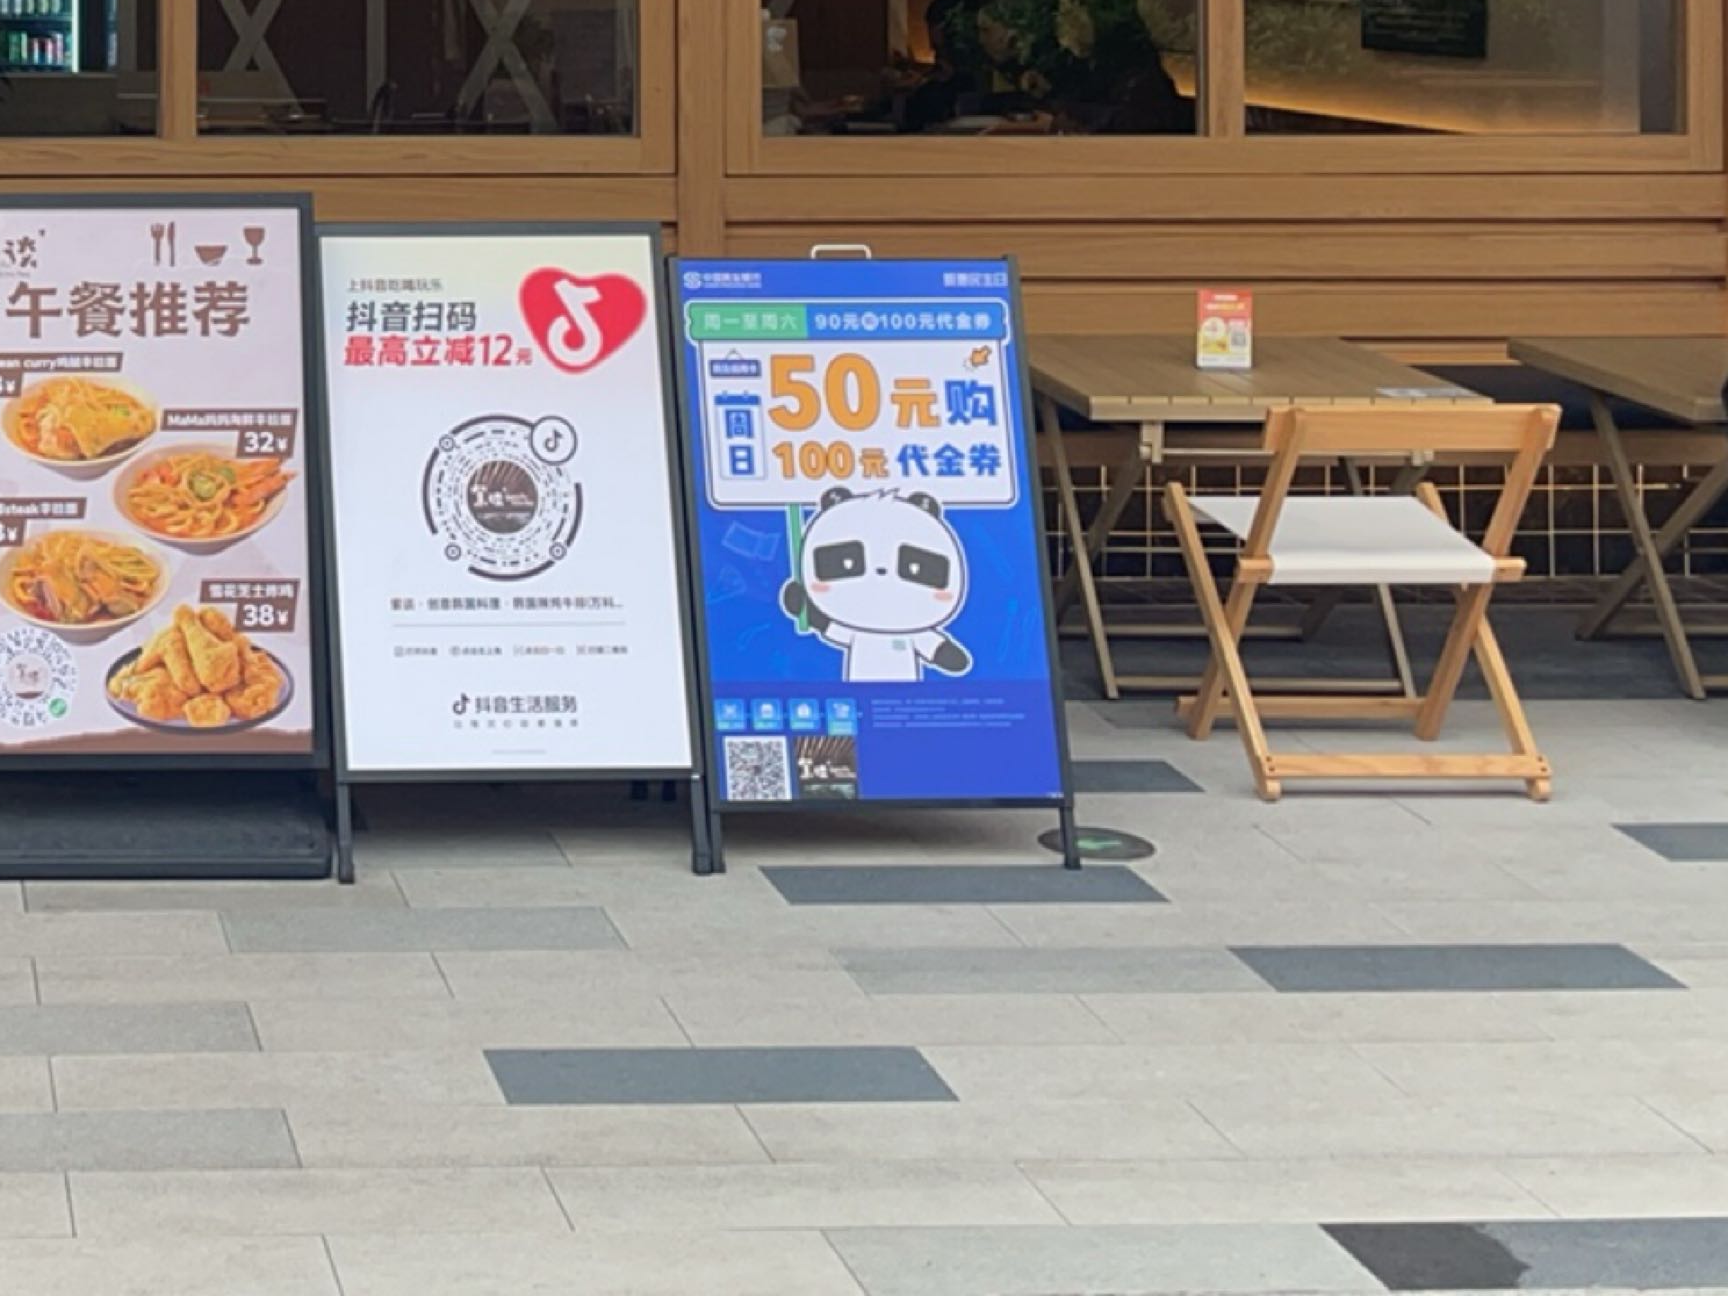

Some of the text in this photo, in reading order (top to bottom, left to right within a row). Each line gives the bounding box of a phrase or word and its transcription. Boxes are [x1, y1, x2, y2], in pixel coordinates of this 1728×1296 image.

[6, 281, 252, 338] 午餐推荐
[347, 301, 476, 333] 抖音扫码
[703, 312, 799, 331] 周一至周六
[344, 333, 533, 367] 最高立减12元
[773, 441, 1002, 480] 100元代金券
[474, 695, 578, 714] 抖音生活服务
